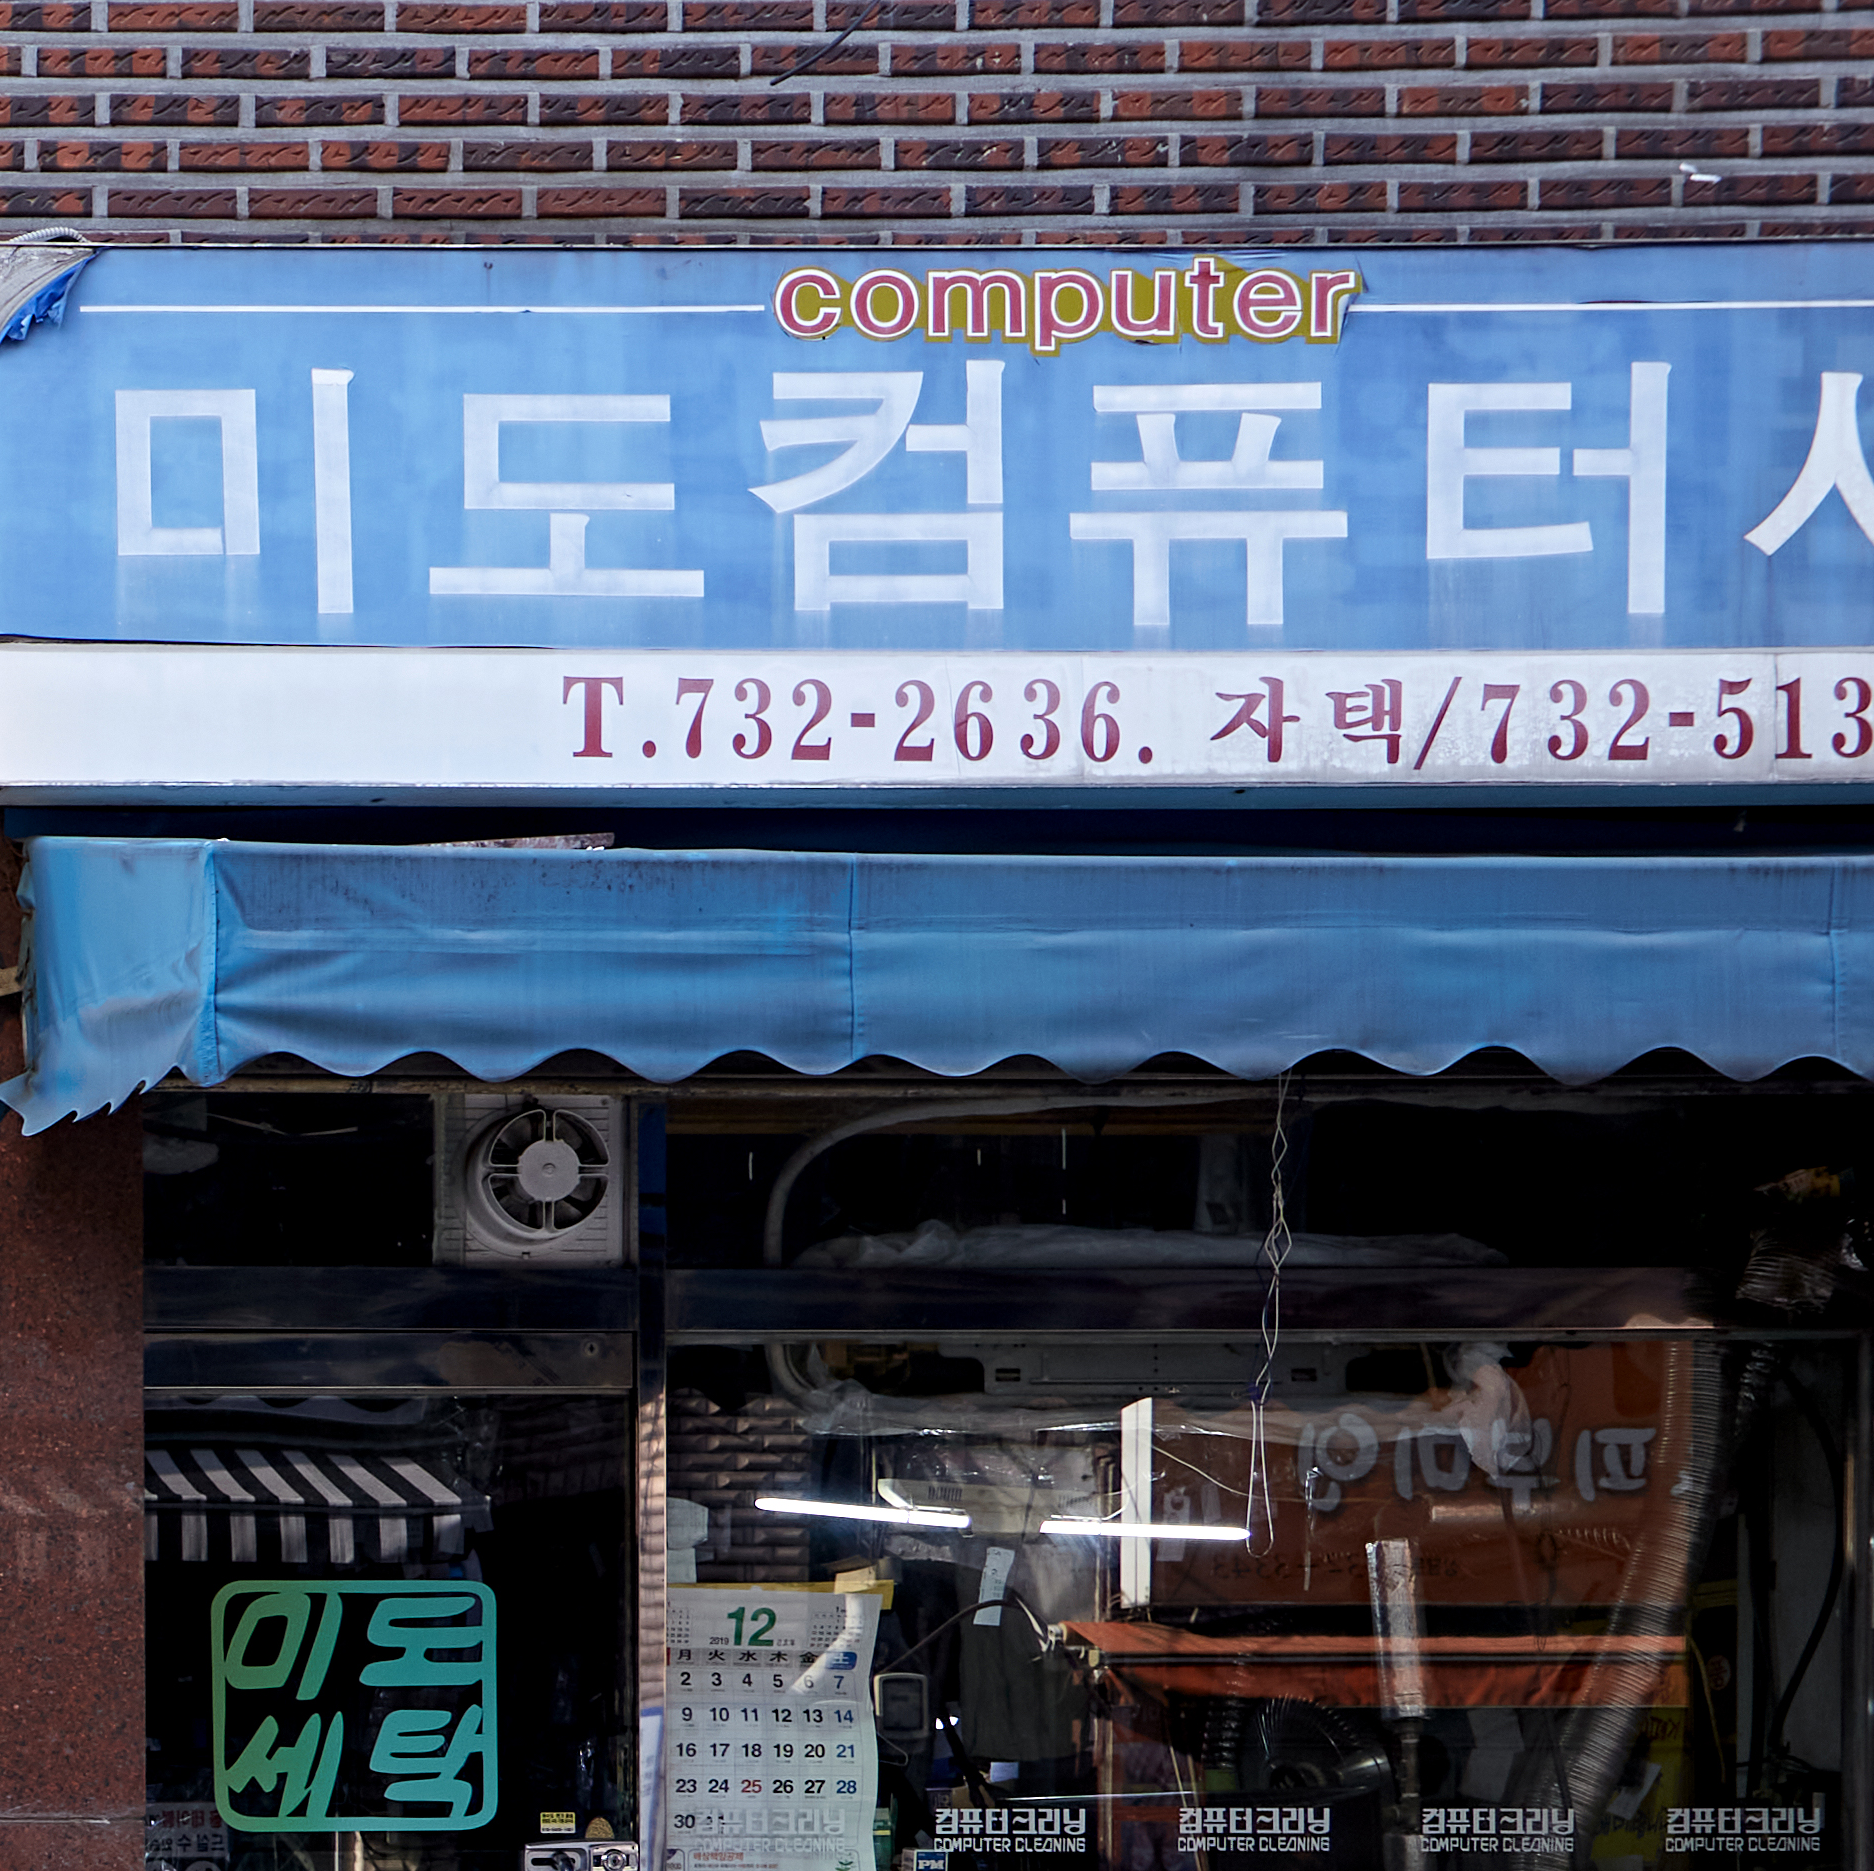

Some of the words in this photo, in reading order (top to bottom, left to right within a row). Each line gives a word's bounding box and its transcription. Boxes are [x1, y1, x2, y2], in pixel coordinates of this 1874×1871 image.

[773, 255, 1358, 351] computer
[727, 1606, 777, 1647] 12
[709, 1636, 730, 1646] 2019
[678, 1649, 692, 1661] 月
[708, 1649, 726, 1662] 火
[739, 1650, 760, 1662] 水
[769, 1651, 788, 1663] 木
[679, 1671, 692, 1686] 2
[711, 1671, 723, 1687] 3
[742, 1672, 753, 1688] 4
[772, 1674, 784, 1688] 5
[833, 1675, 845, 1690] 7
[681, 1706, 693, 1722] 9
[709, 1706, 730, 1722] 10
[740, 1707, 760, 1722] 11
[771, 1708, 793, 1723] 12
[803, 1708, 824, 1723] 13
[834, 1709, 855, 1724] 14
[675, 1742, 697, 1758] 16
[709, 1743, 731, 1758] 17
[741, 1743, 762, 1758] 18
[773, 1743, 794, 1758] 19
[804, 1743, 826, 1759] 20
[835, 1744, 856, 1759] 21
[675, 1778, 697, 1793] 23
[707, 1778, 729, 1793] 24
[740, 1779, 762, 1794] 25
[772, 1779, 794, 1794] 26
[803, 1779, 826, 1795] 27
[835, 1780, 857, 1795] 28
[673, 1814, 696, 1829] 30
[935, 1807, 1086, 1835] 컴퓨터크리닝
[1179, 1807, 1330, 1834] 컴퓨터크리닝
[1421, 1807, 1575, 1835] 컴퓨터크리닝
[1666, 1807, 1821, 1835] 컴퓨터크리닝
[933, 1837, 1011, 1853] COMPUTER
[1177, 1836, 1254, 1852] COMPUTER
[1420, 1836, 1499, 1853] COMPUTER
[1665, 1836, 1743, 1853] COMPUTER
